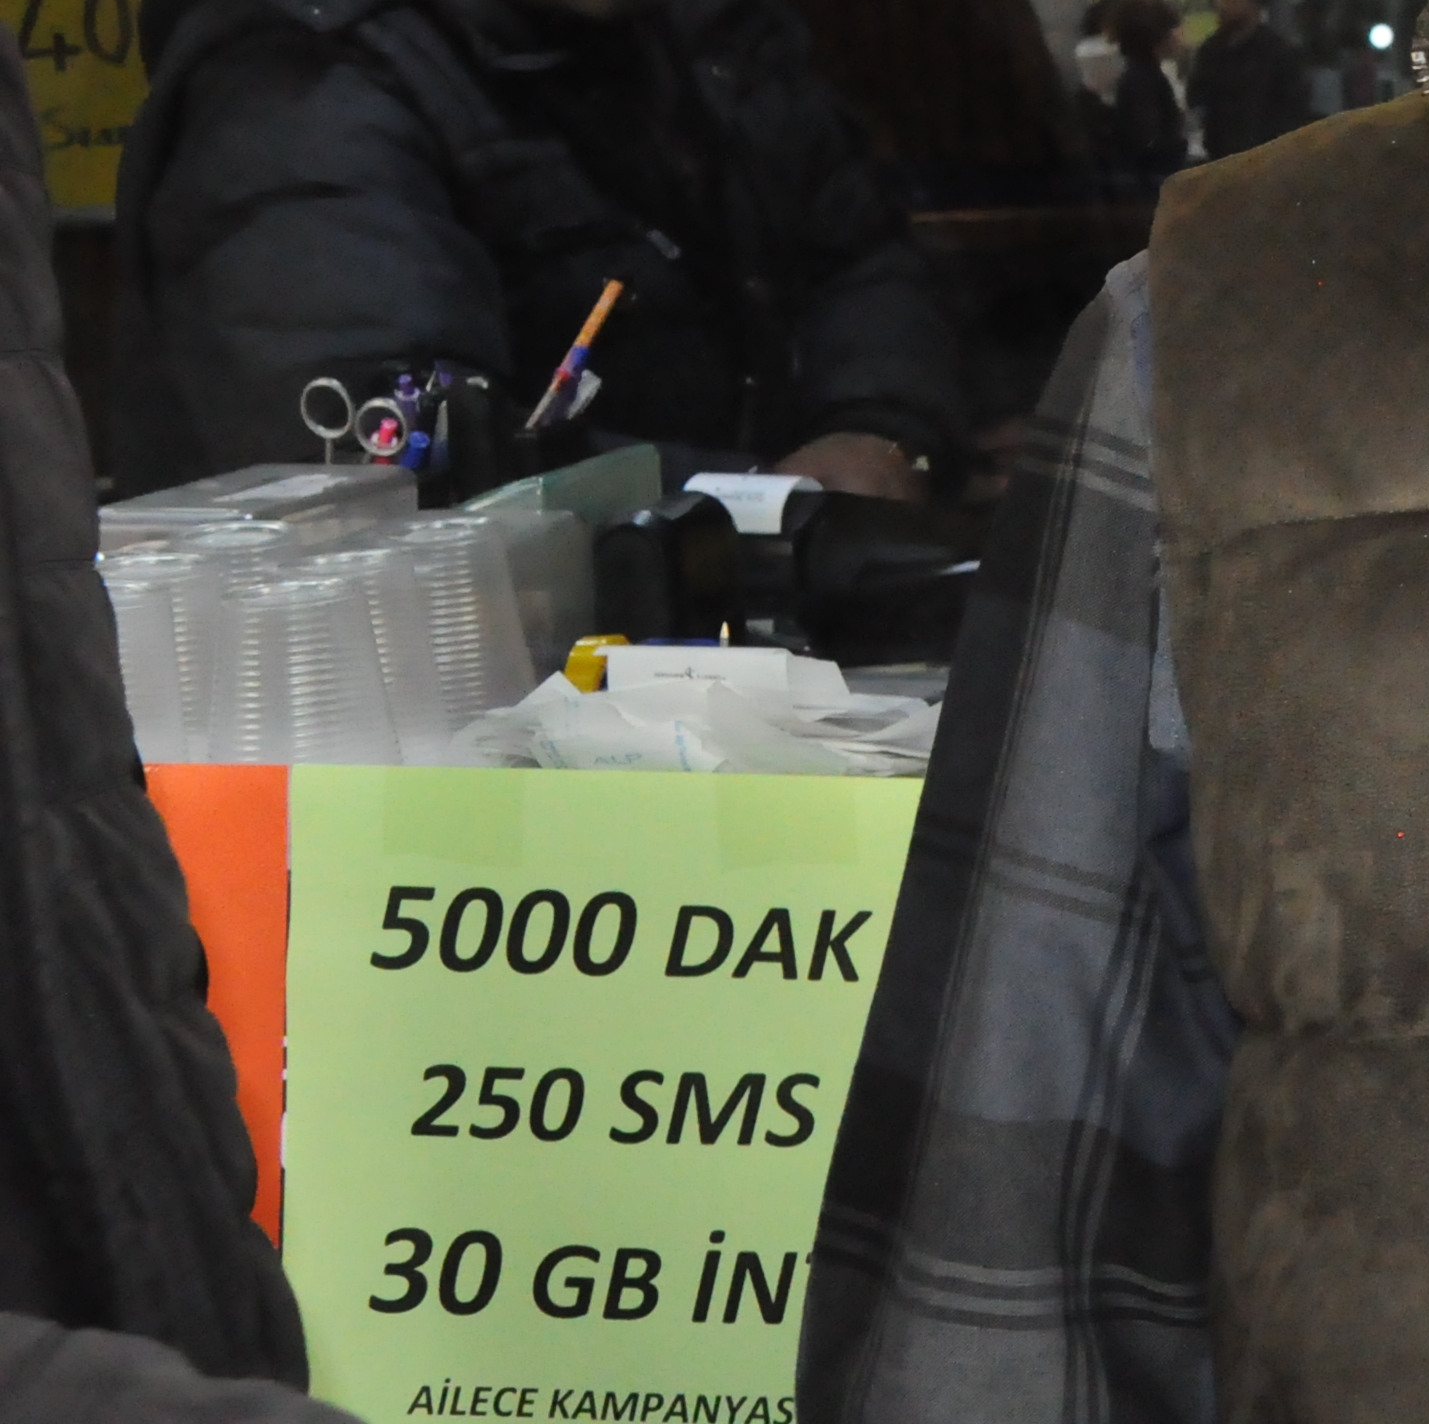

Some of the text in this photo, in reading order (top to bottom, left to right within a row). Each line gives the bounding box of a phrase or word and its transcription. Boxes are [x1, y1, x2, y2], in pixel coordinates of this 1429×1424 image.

[370, 885, 873, 983] 5000 DAK
[410, 1063, 820, 1148] 250 SMS
[368, 1227, 812, 1325] 30 GB İN
[407, 1377, 795, 1424] AİLECE KAMPANYAS
